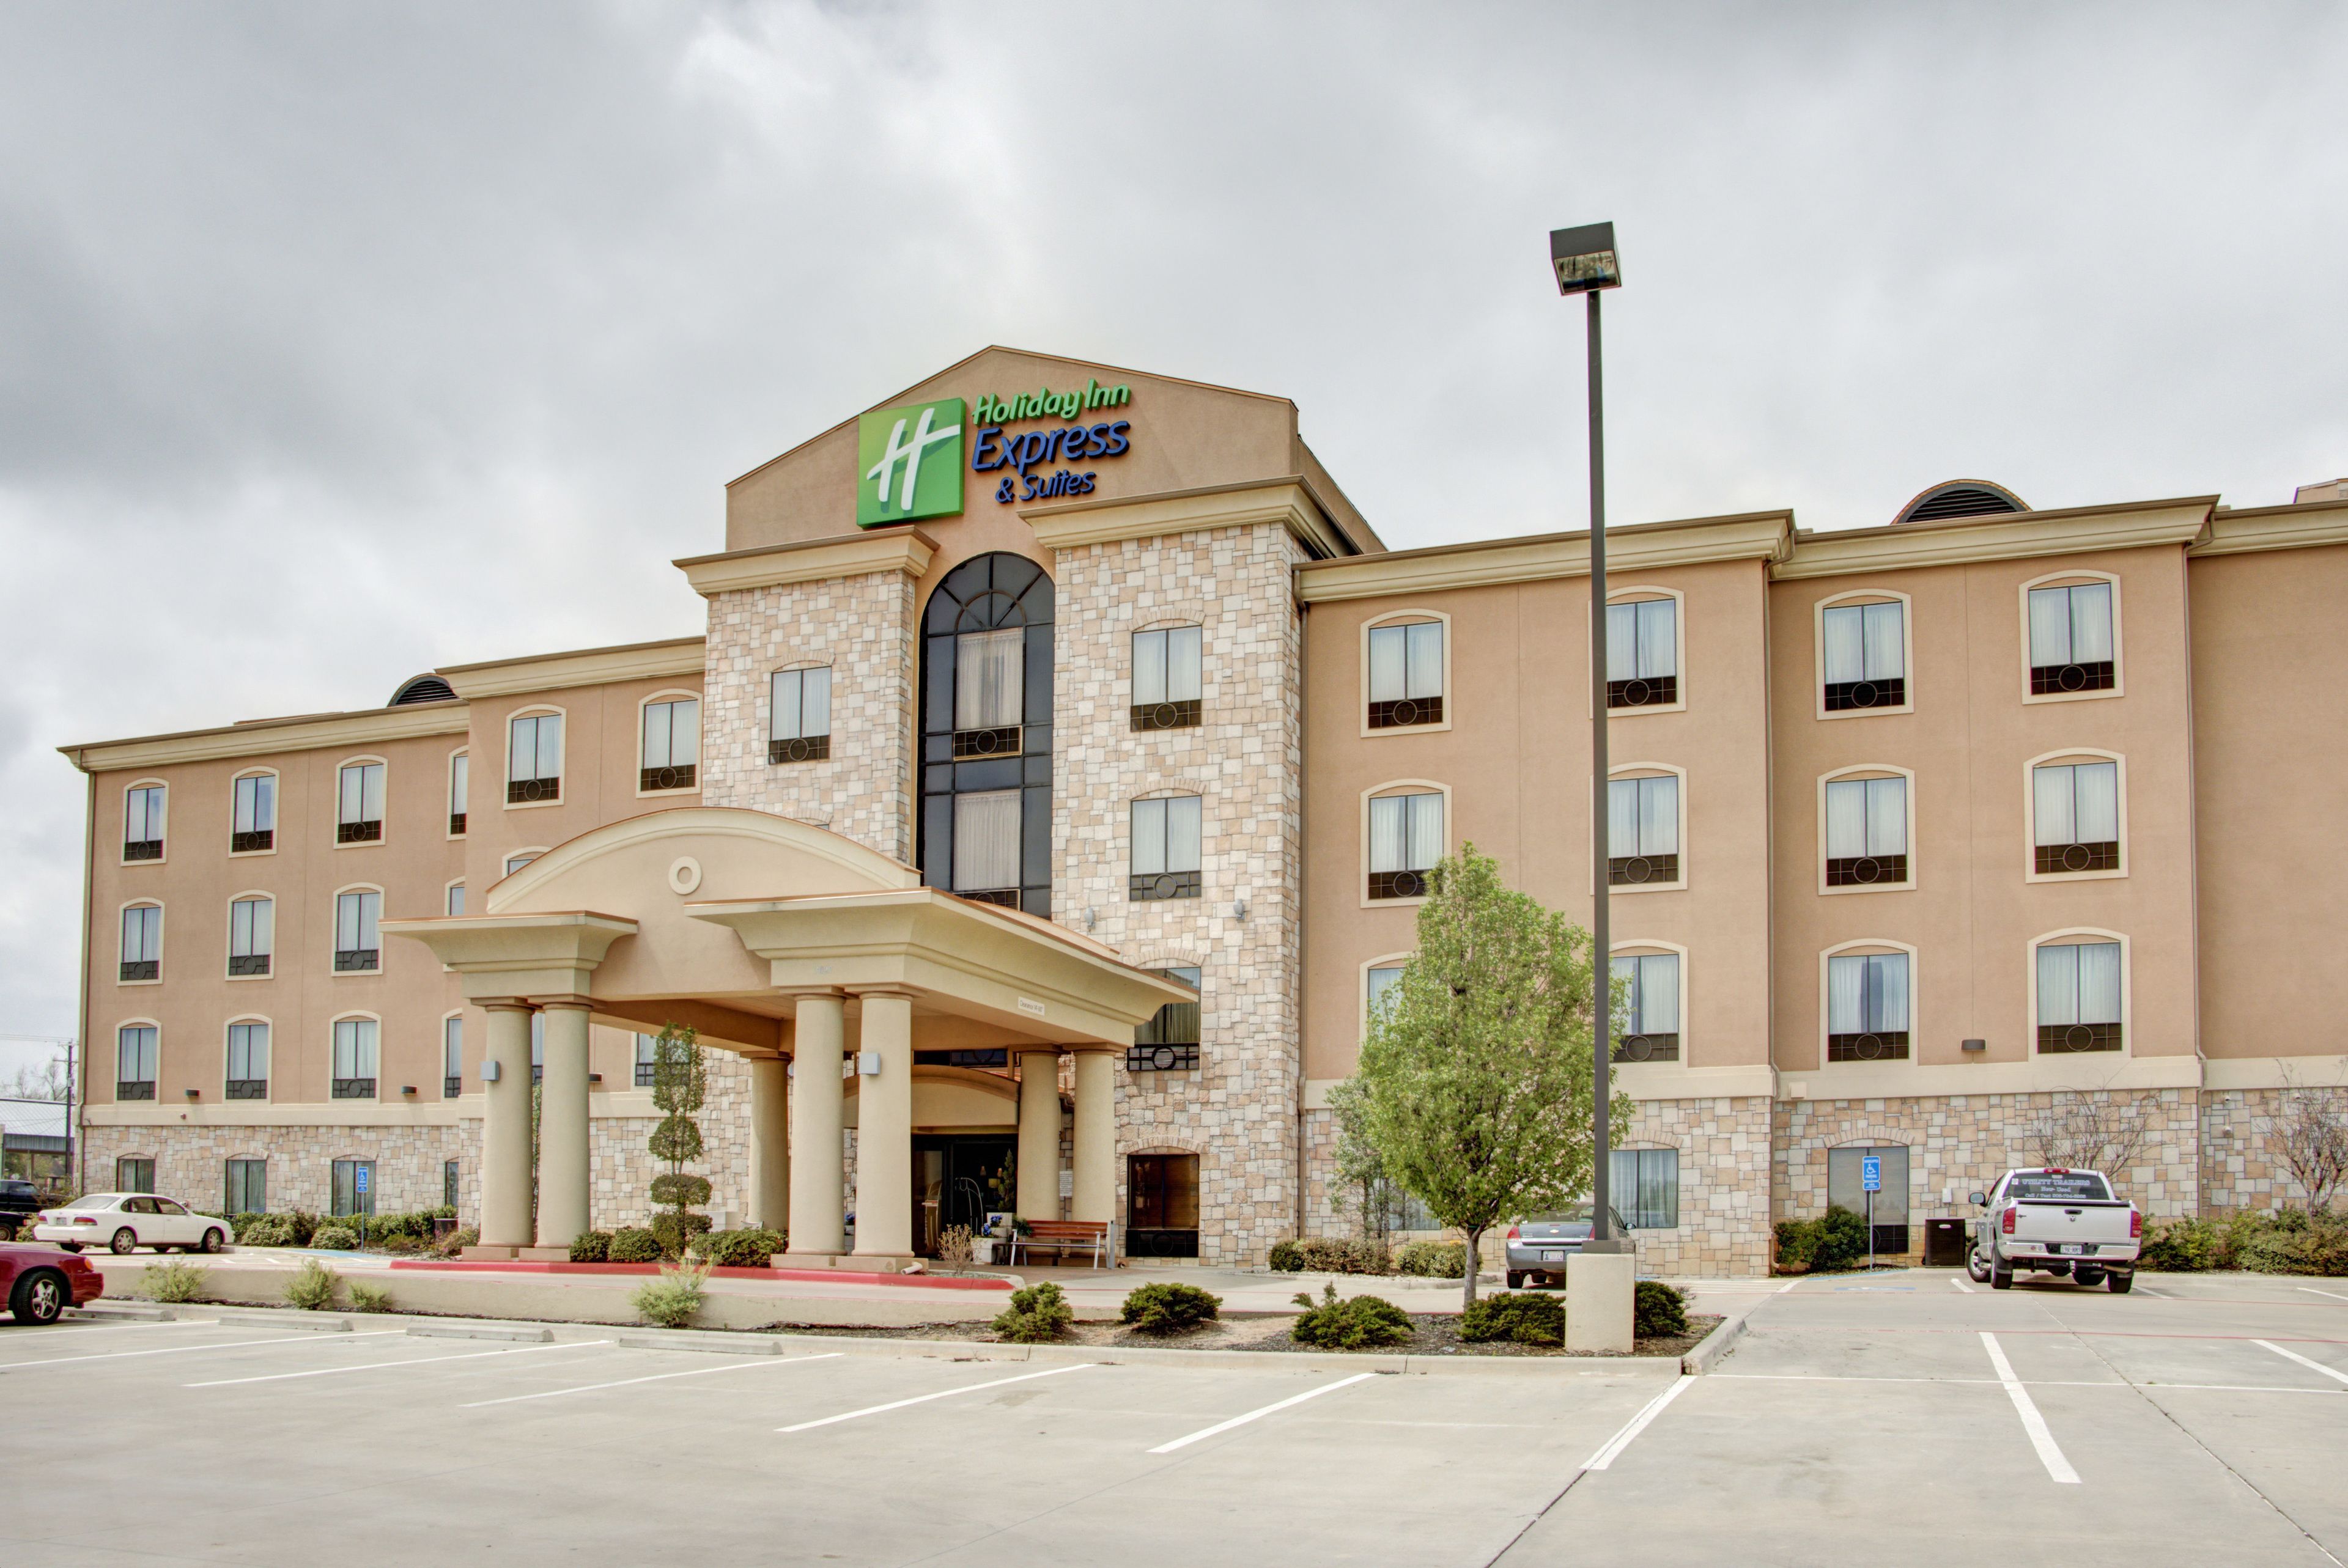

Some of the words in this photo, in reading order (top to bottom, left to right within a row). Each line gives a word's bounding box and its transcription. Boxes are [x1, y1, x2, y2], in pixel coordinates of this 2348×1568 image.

[972, 386, 1083, 425] Holiday
[1084, 378, 1131, 409] Inn
[971, 421, 1131, 476] Express
[995, 476, 1014, 504] &
[1019, 469, 1096, 501] Suites
